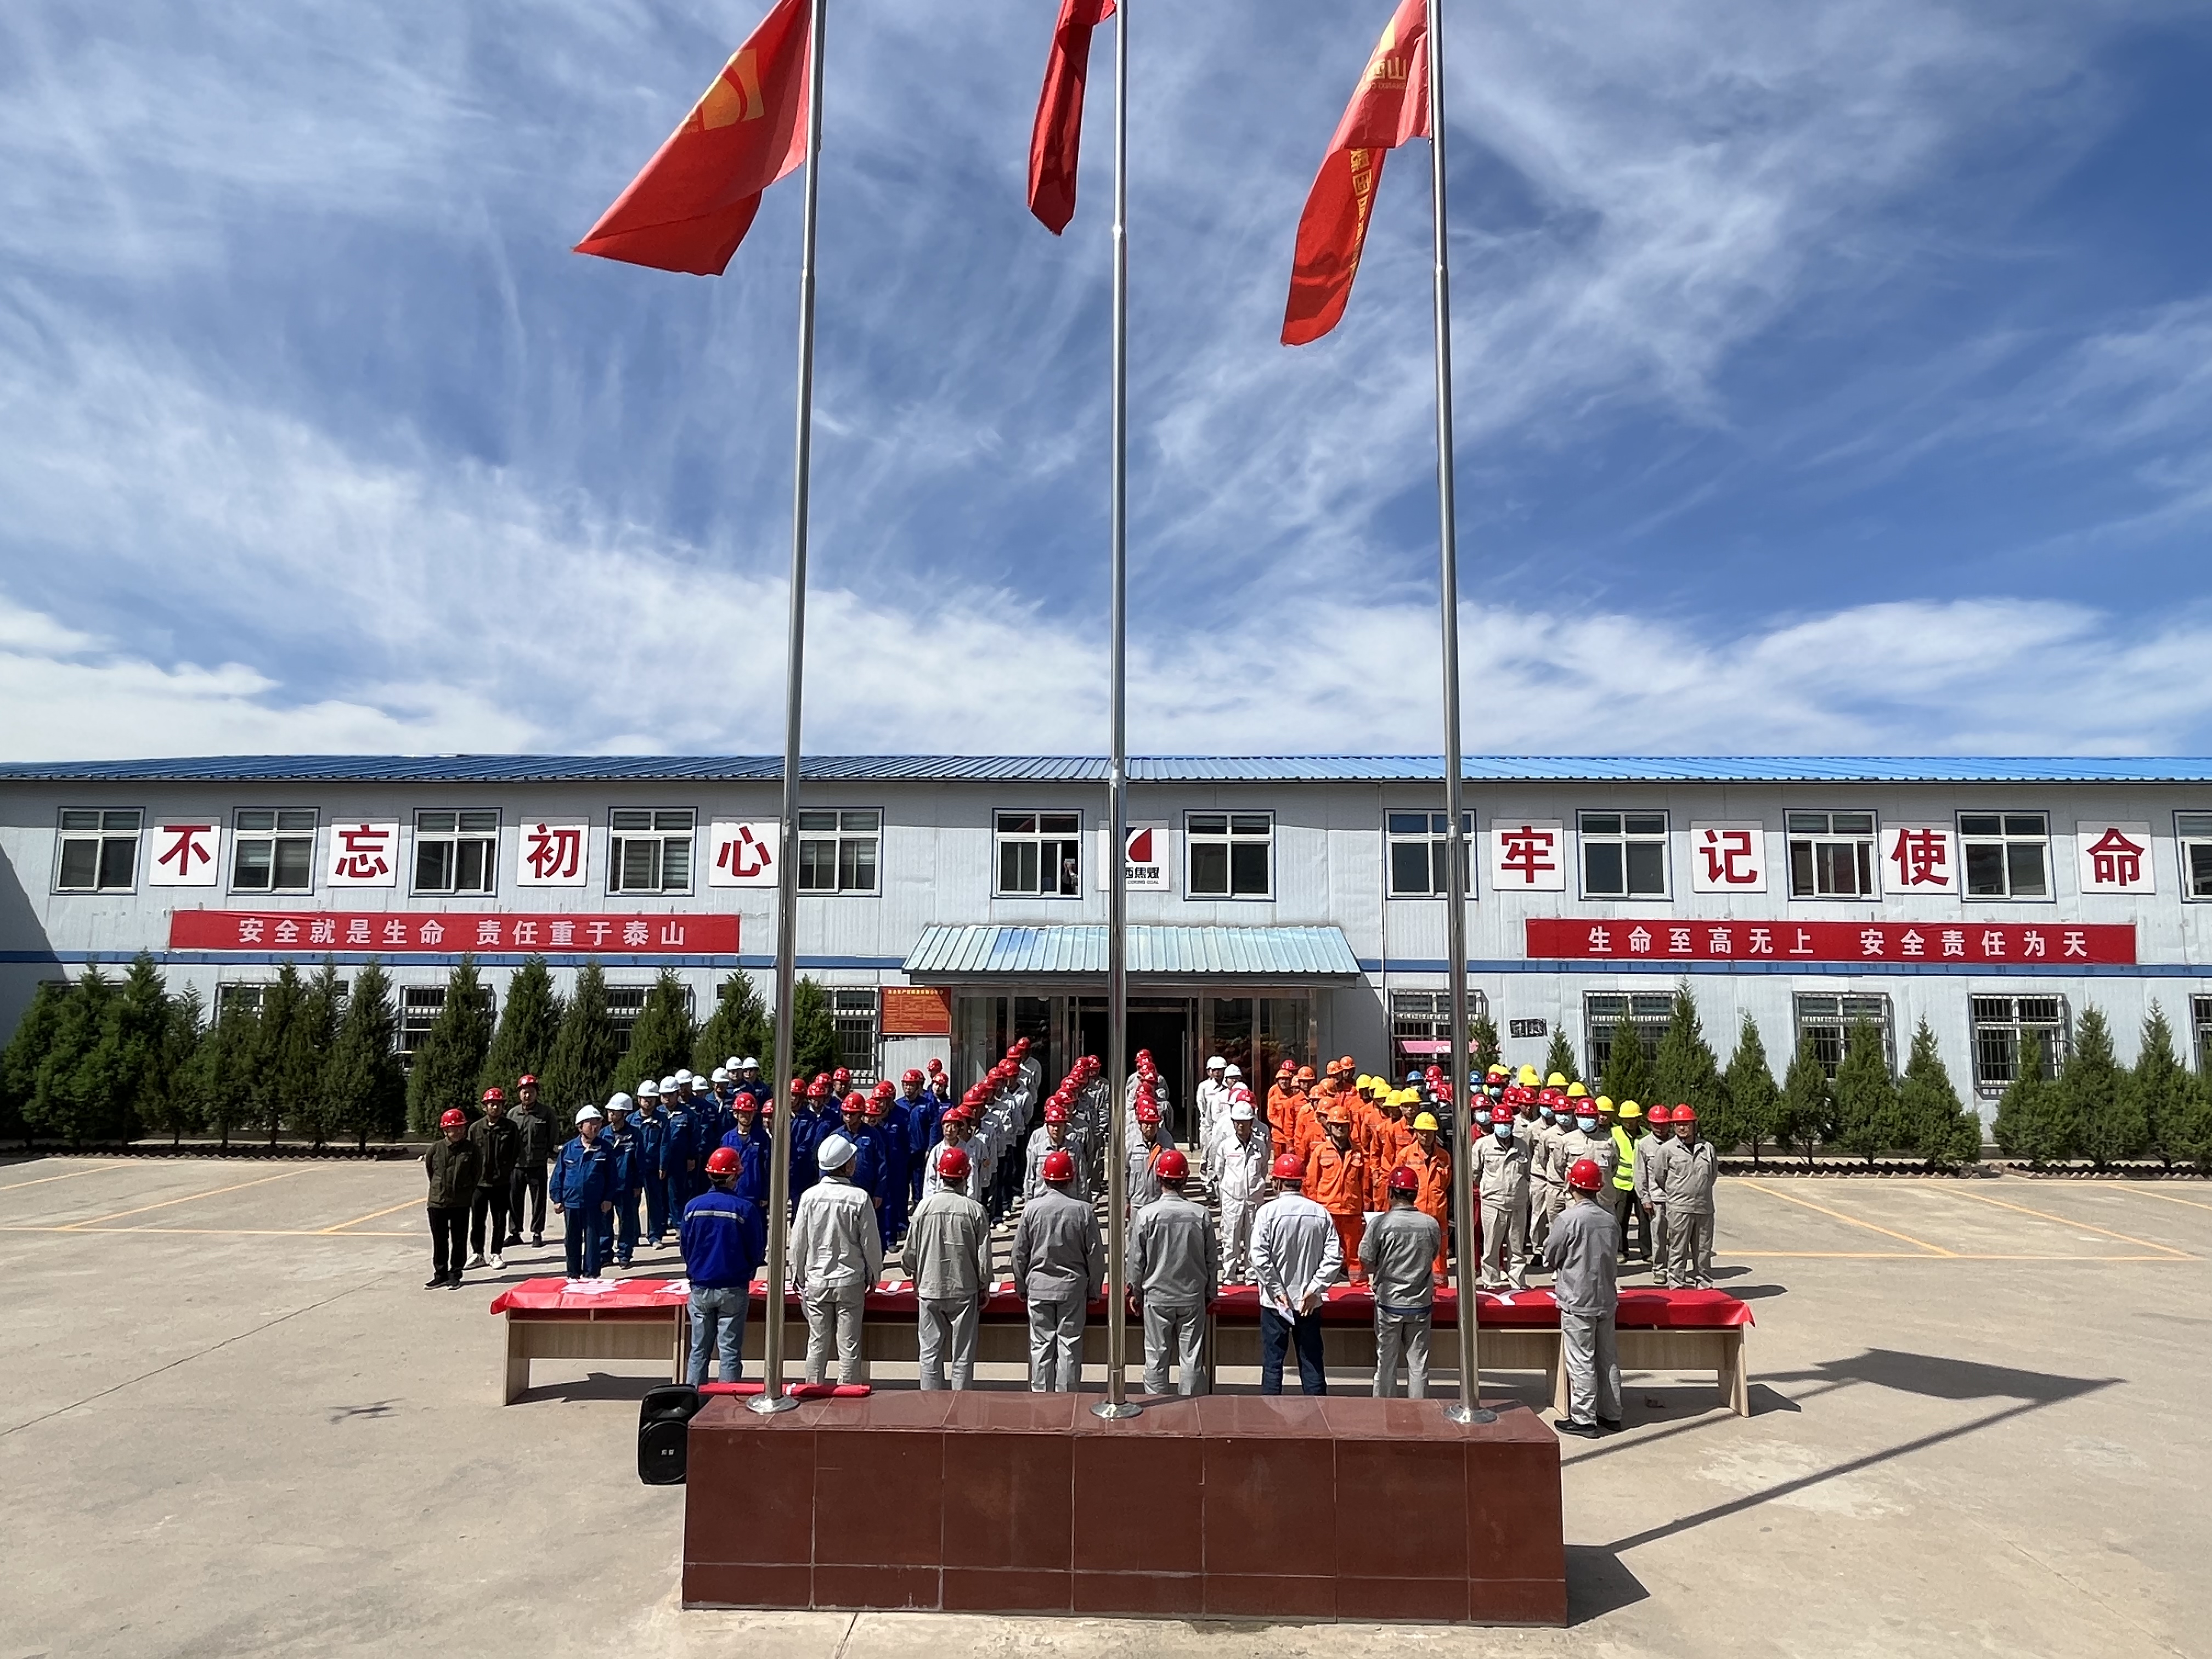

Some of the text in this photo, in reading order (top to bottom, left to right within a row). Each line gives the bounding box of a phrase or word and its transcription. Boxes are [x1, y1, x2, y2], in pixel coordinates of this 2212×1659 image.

[1125, 867, 1160, 879] 西焦煤
[238, 918, 685, 947] 安全就是生命 责任重于泰山
[1588, 926, 2088, 957] 生命至高无上 安全责任为天
